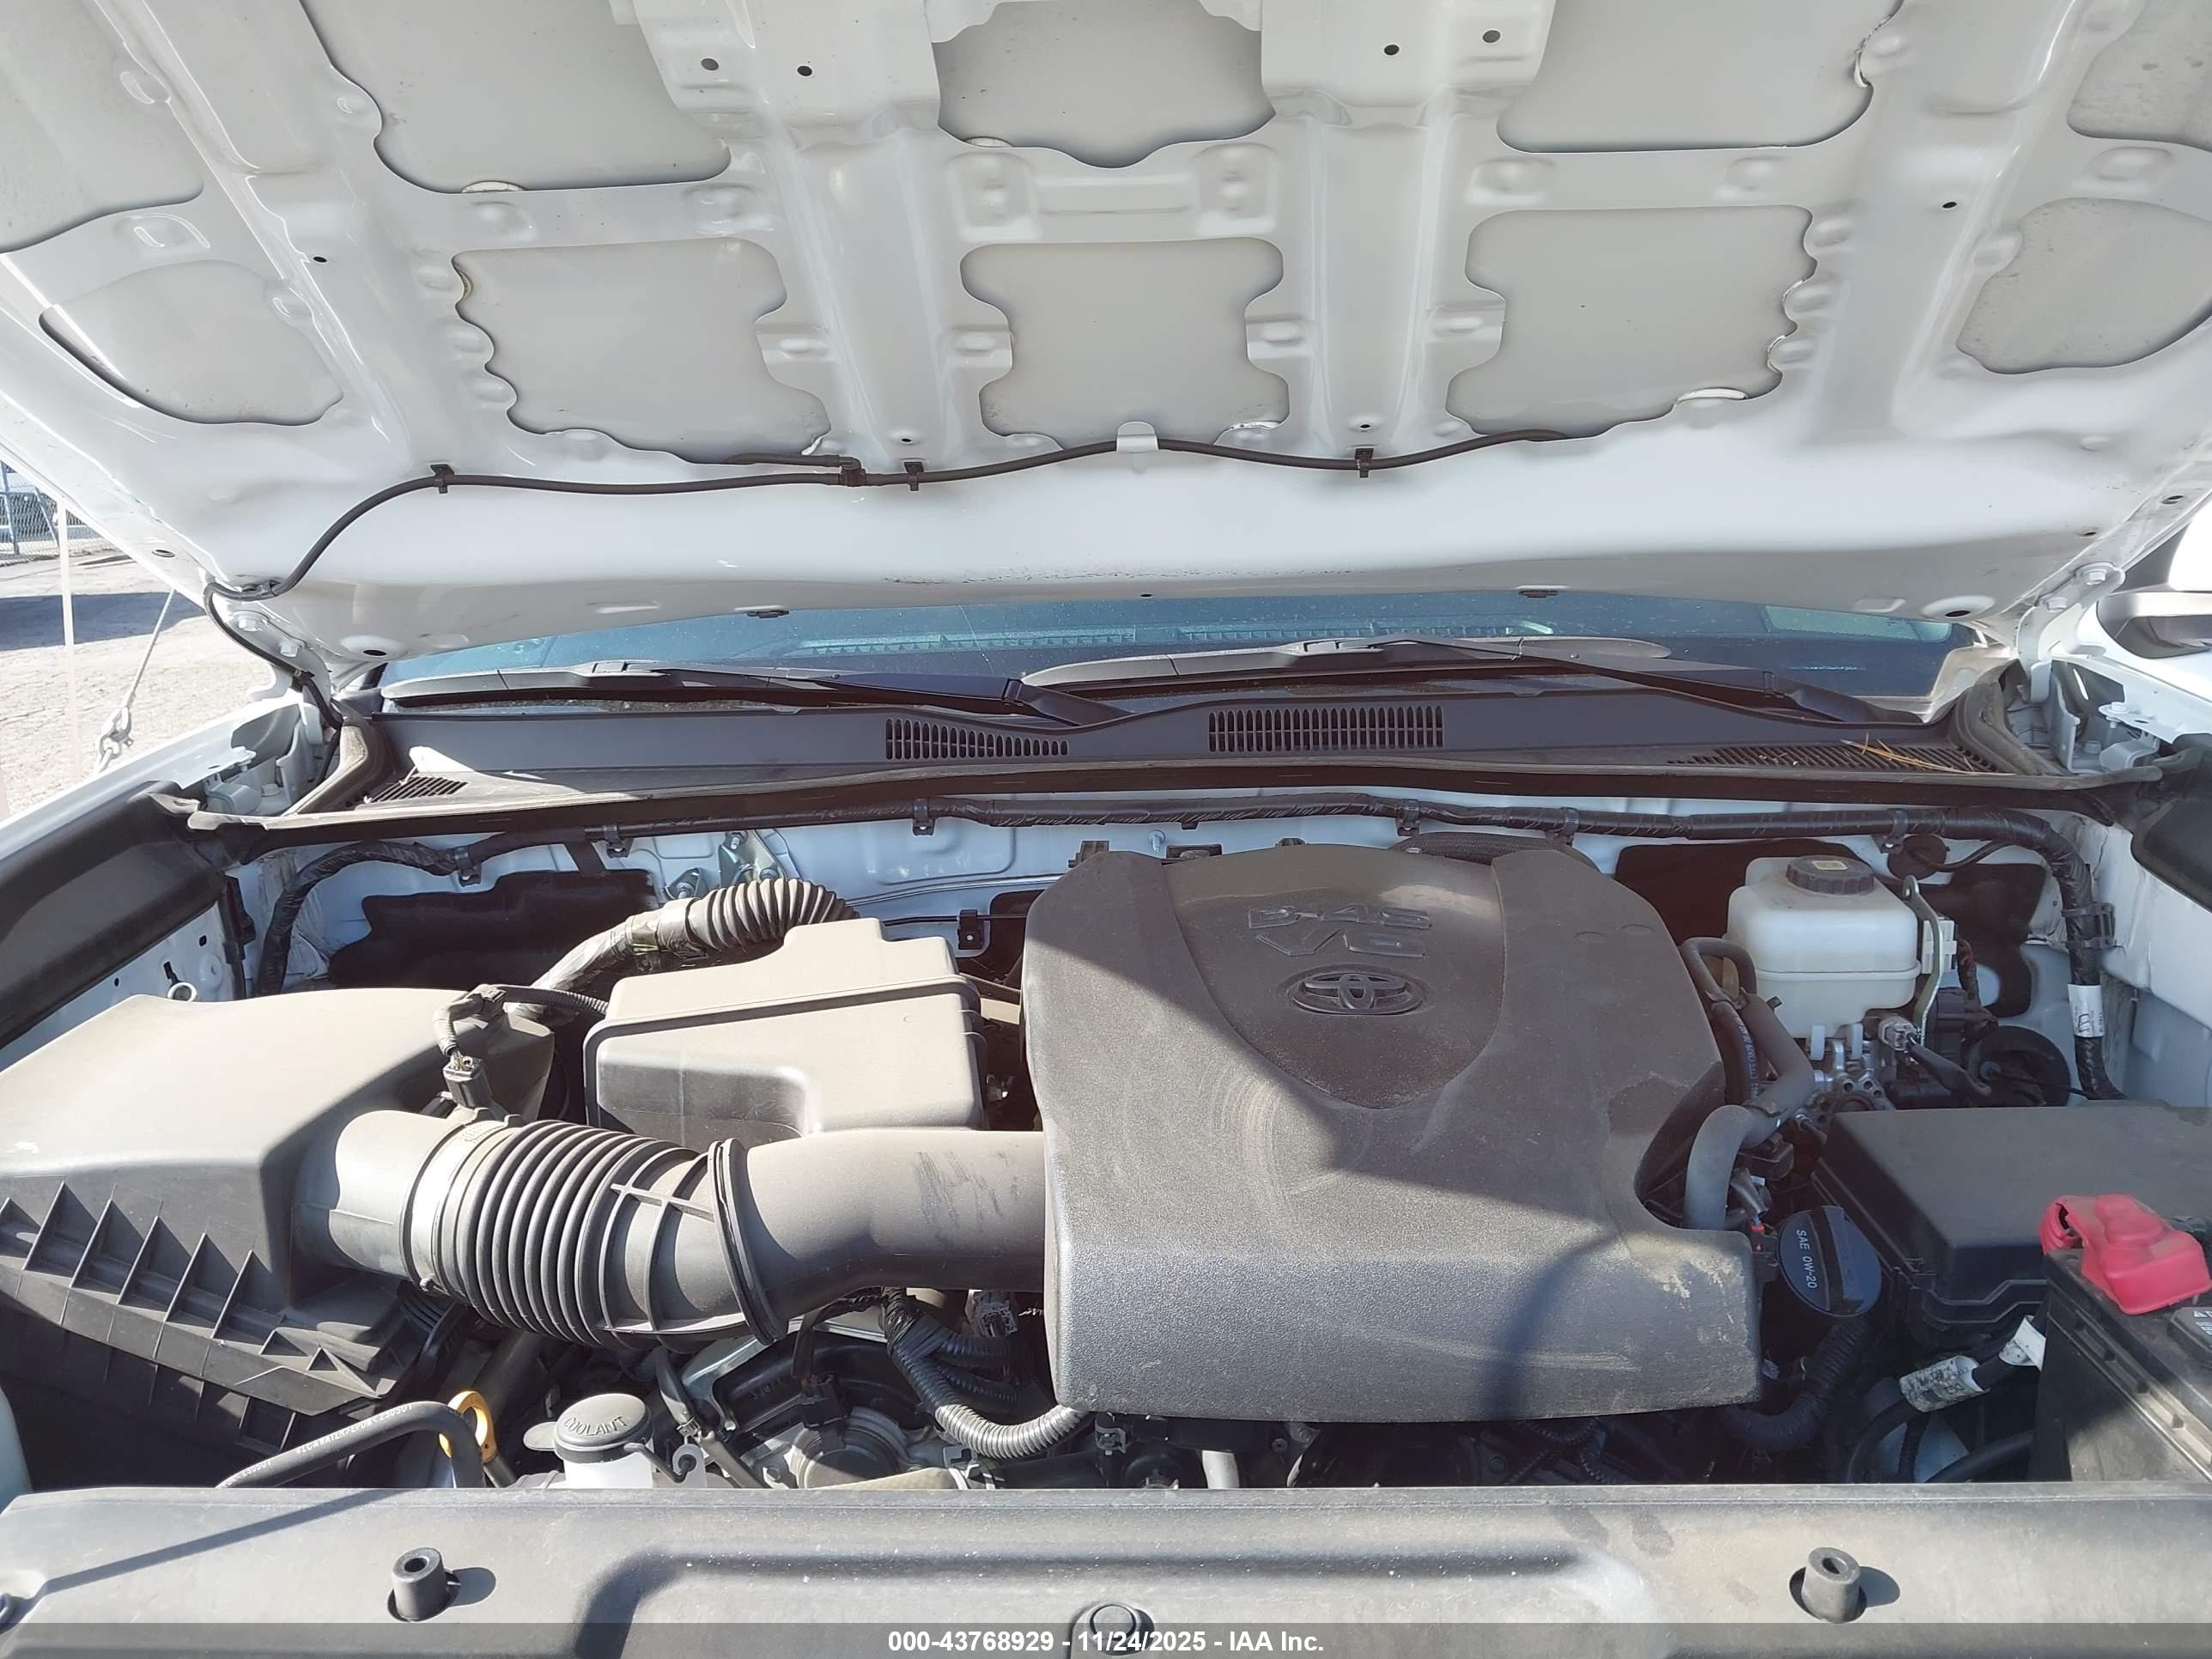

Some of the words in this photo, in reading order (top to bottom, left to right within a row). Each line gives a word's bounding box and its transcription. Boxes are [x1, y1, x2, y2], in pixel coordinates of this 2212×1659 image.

[1255, 927, 1426, 957] V6
[1796, 1229, 1810, 1250] SAE
[1802, 1255, 1818, 1289] 0W-20
[564, 1416, 629, 1437] COOLANT
